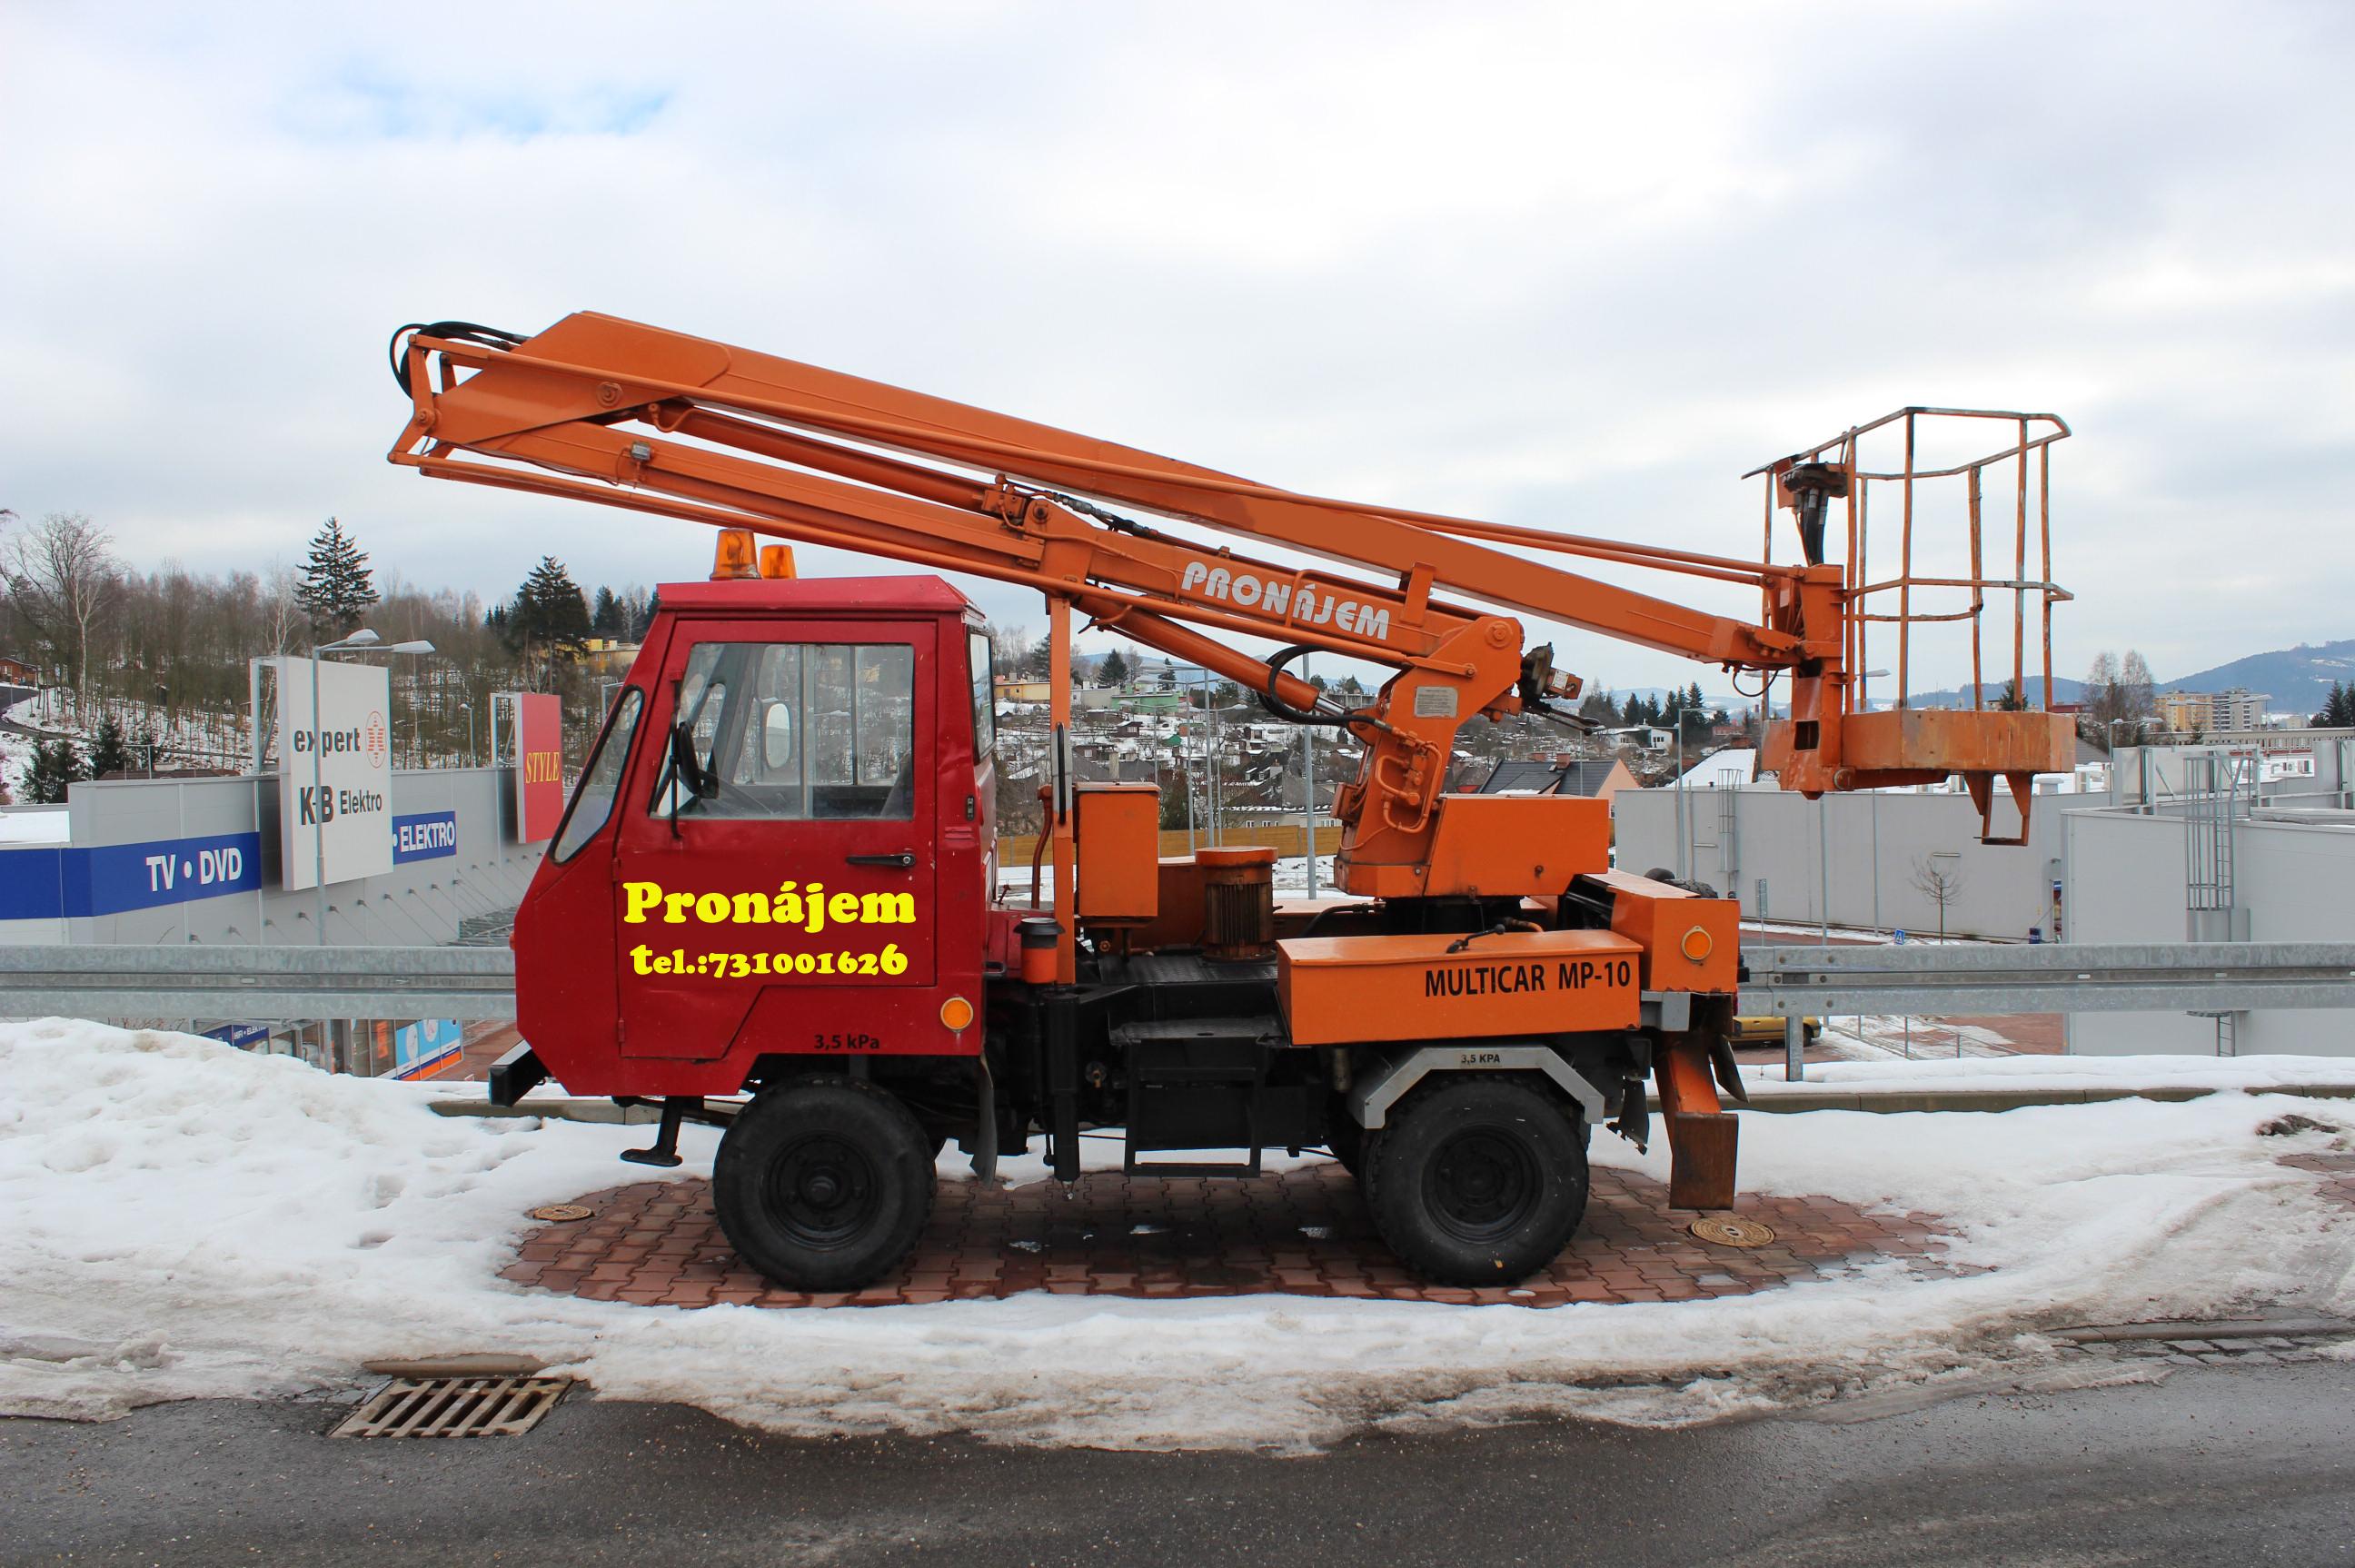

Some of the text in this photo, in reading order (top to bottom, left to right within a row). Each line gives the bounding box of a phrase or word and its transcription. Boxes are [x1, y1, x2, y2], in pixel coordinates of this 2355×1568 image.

[1181, 561, 1391, 640] PRONÁJEM
[525, 751, 560, 784] STYLE
[339, 789, 383, 815] Elektro
[400, 820, 455, 853] ELEKTRO
[145, 847, 243, 892] TV DVD
[622, 880, 917, 934] Pronájem
[630, 943, 909, 978] tel.:731001626
[1426, 960, 1631, 997] MULTICAR MP-10
[814, 1032, 880, 1051] 3,5 kPa
[1461, 1054, 1501, 1064] 3,5 KPA
